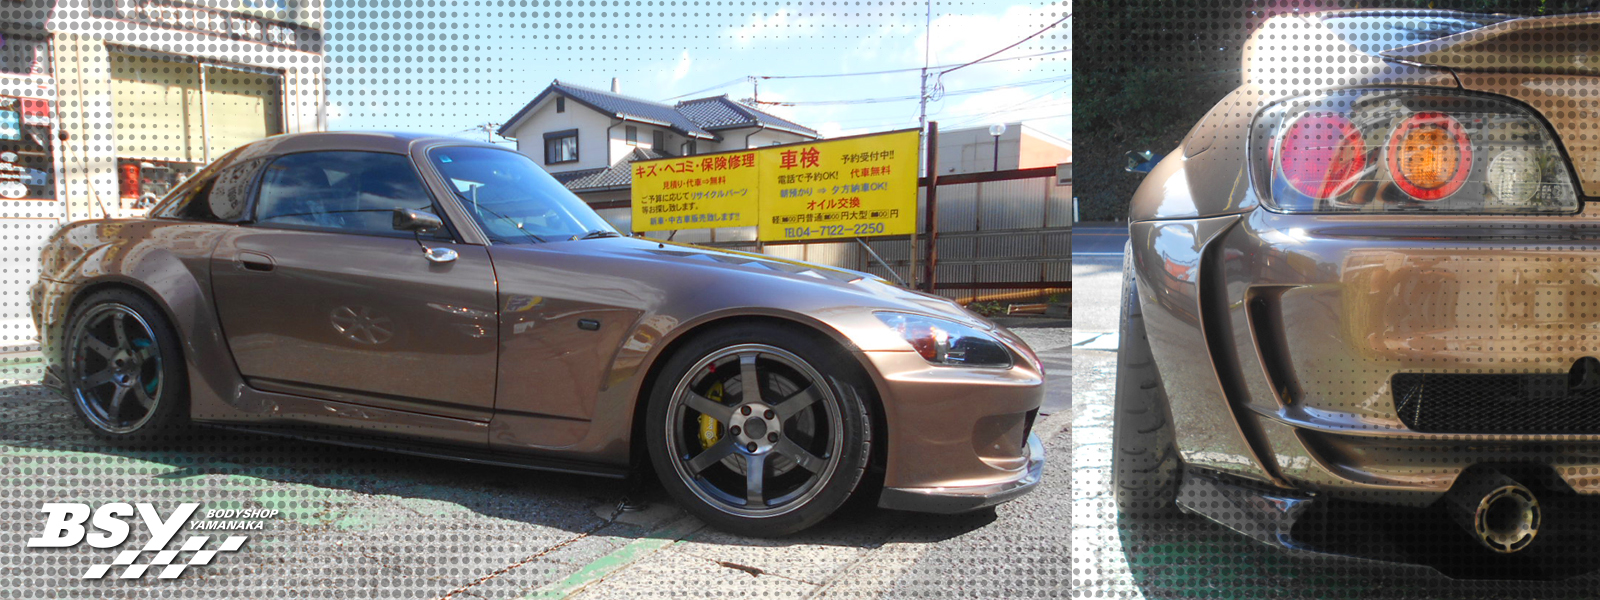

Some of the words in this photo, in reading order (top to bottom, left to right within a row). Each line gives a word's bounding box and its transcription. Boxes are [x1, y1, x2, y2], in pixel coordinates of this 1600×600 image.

[636, 153, 755, 178] キズ・ヘコミ・保険修理
[780, 147, 820, 170] 車検
[850, 165, 891, 178] 代車無料
[806, 197, 860, 211] オイル交換
